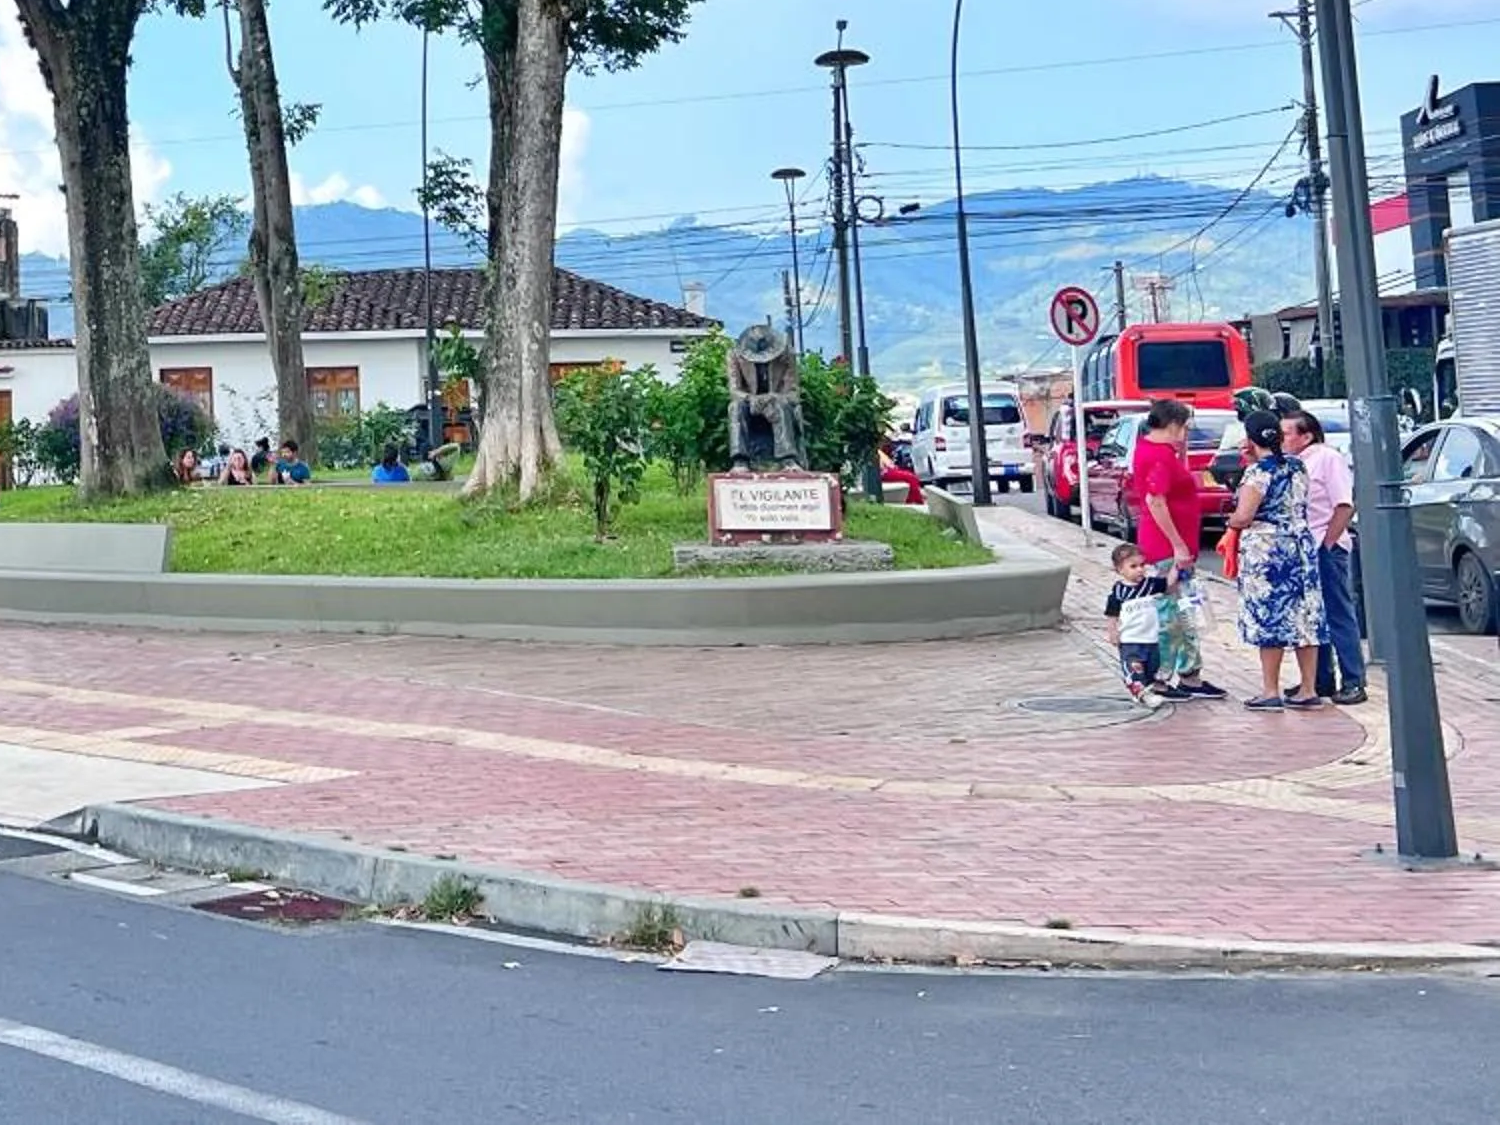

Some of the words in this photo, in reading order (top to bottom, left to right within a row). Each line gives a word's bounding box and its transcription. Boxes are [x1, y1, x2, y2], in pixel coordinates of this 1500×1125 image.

[1066, 298, 1088, 334] P
[731, 490, 746, 501] EL
[749, 488, 819, 501] VIGILANTE
